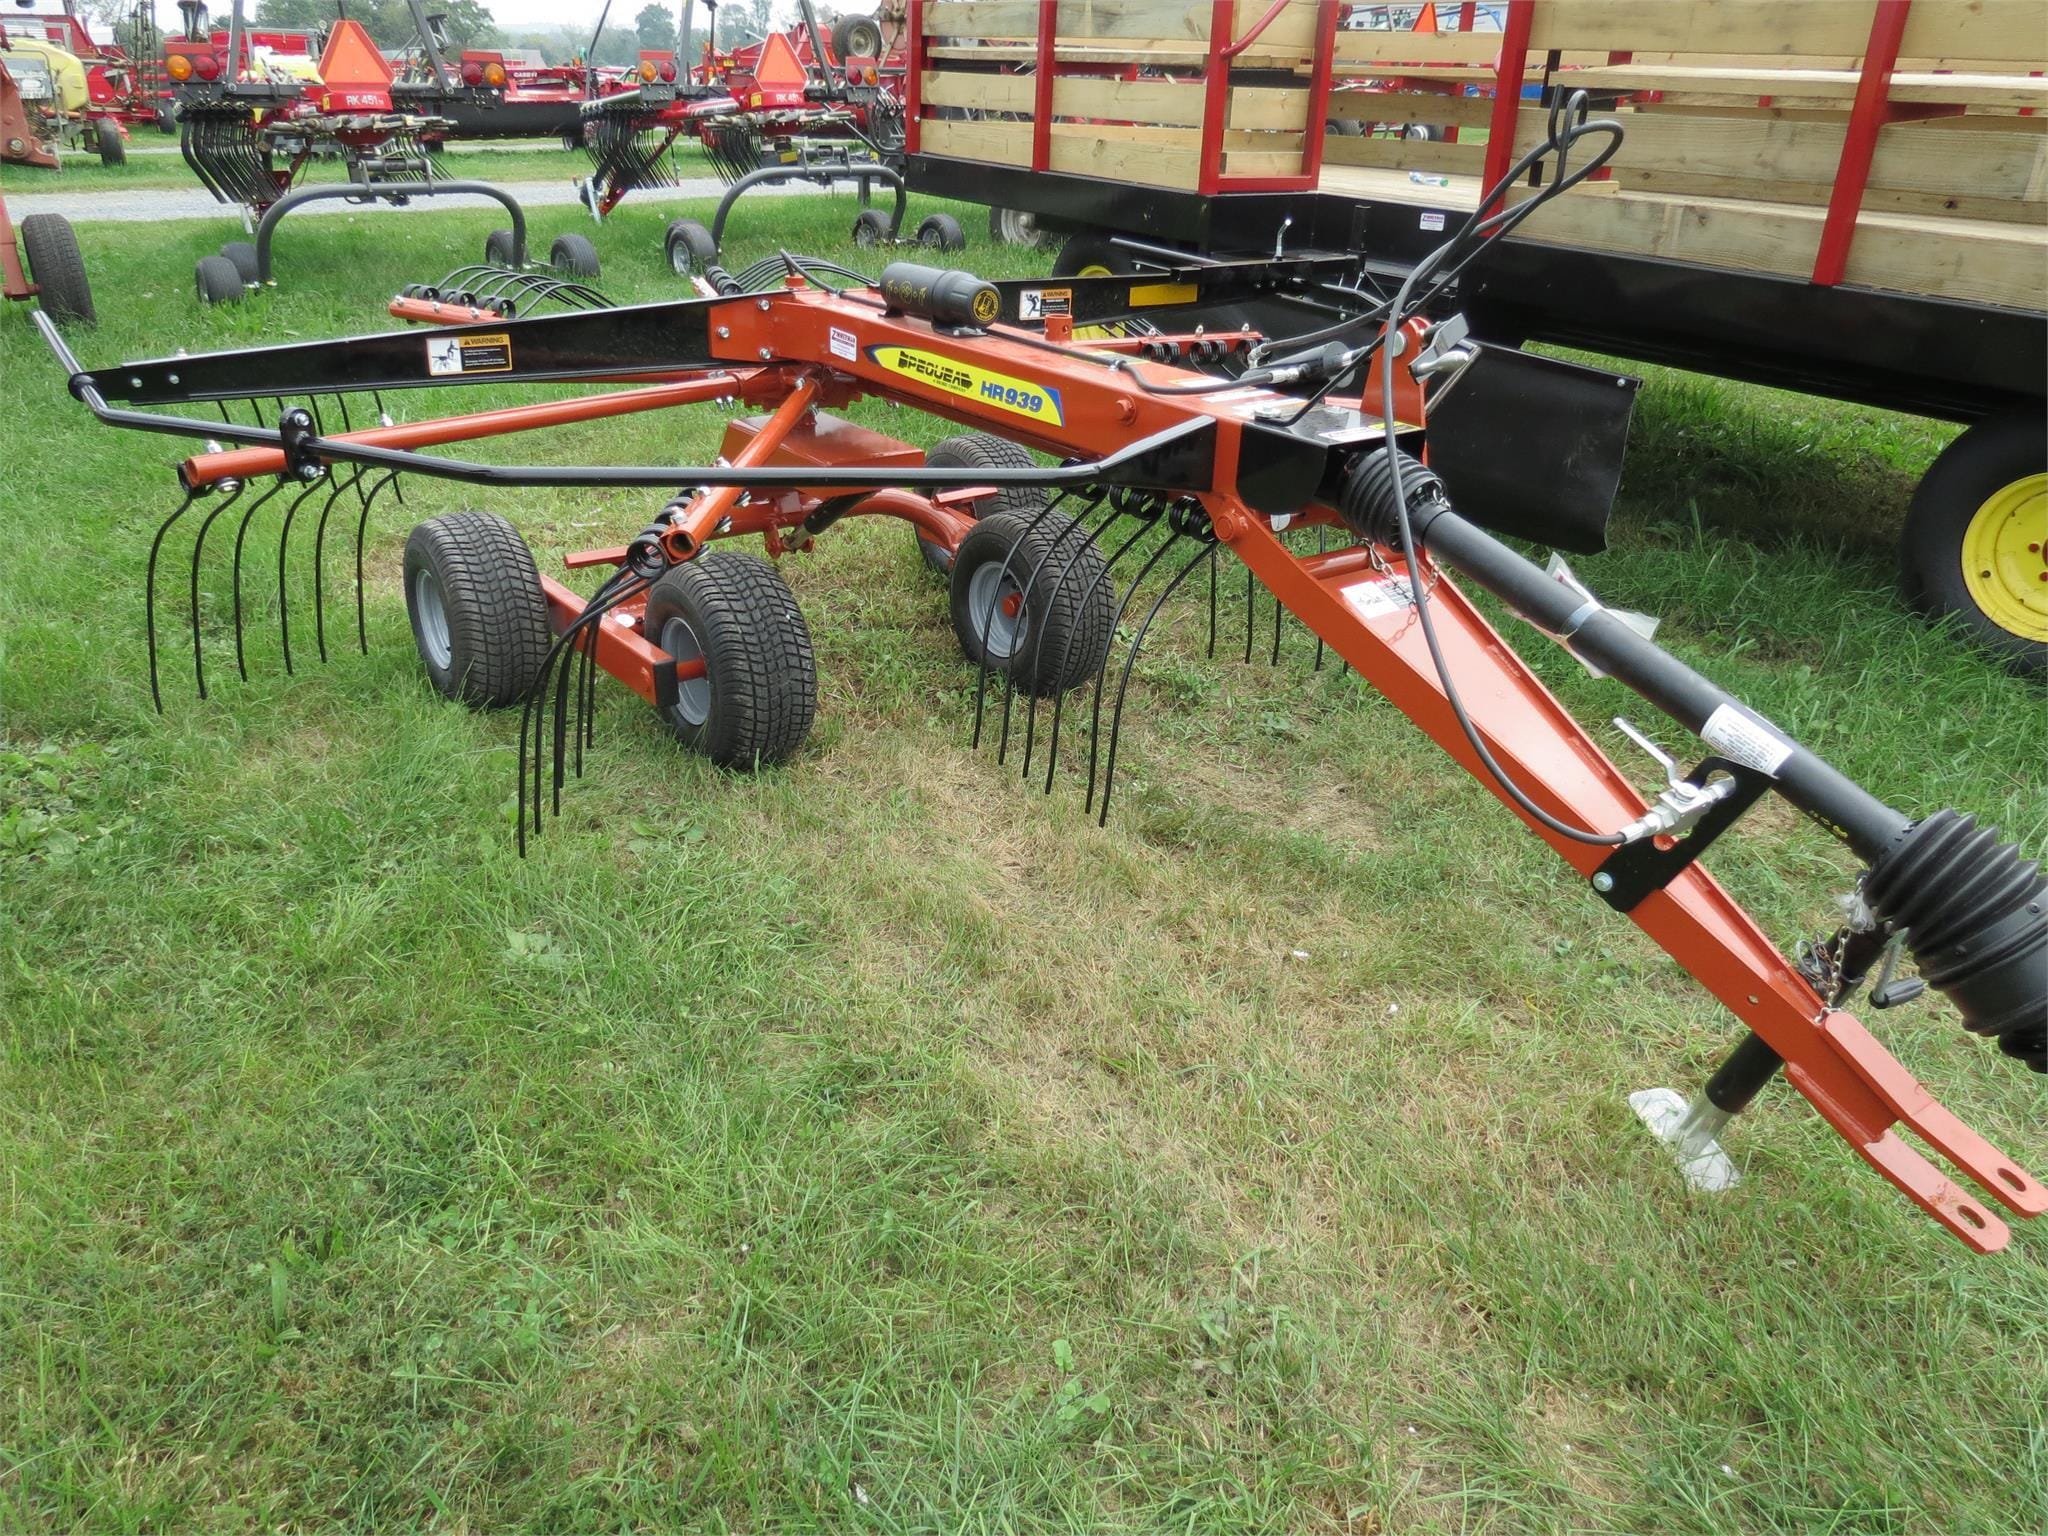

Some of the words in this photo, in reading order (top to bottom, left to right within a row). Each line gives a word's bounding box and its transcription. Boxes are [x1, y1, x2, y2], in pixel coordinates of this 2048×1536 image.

[346, 95, 361, 106] RK
[361, 94, 378, 105] 451
[471, 336, 504, 345] WARNING
[981, 380, 1043, 412] HR939
